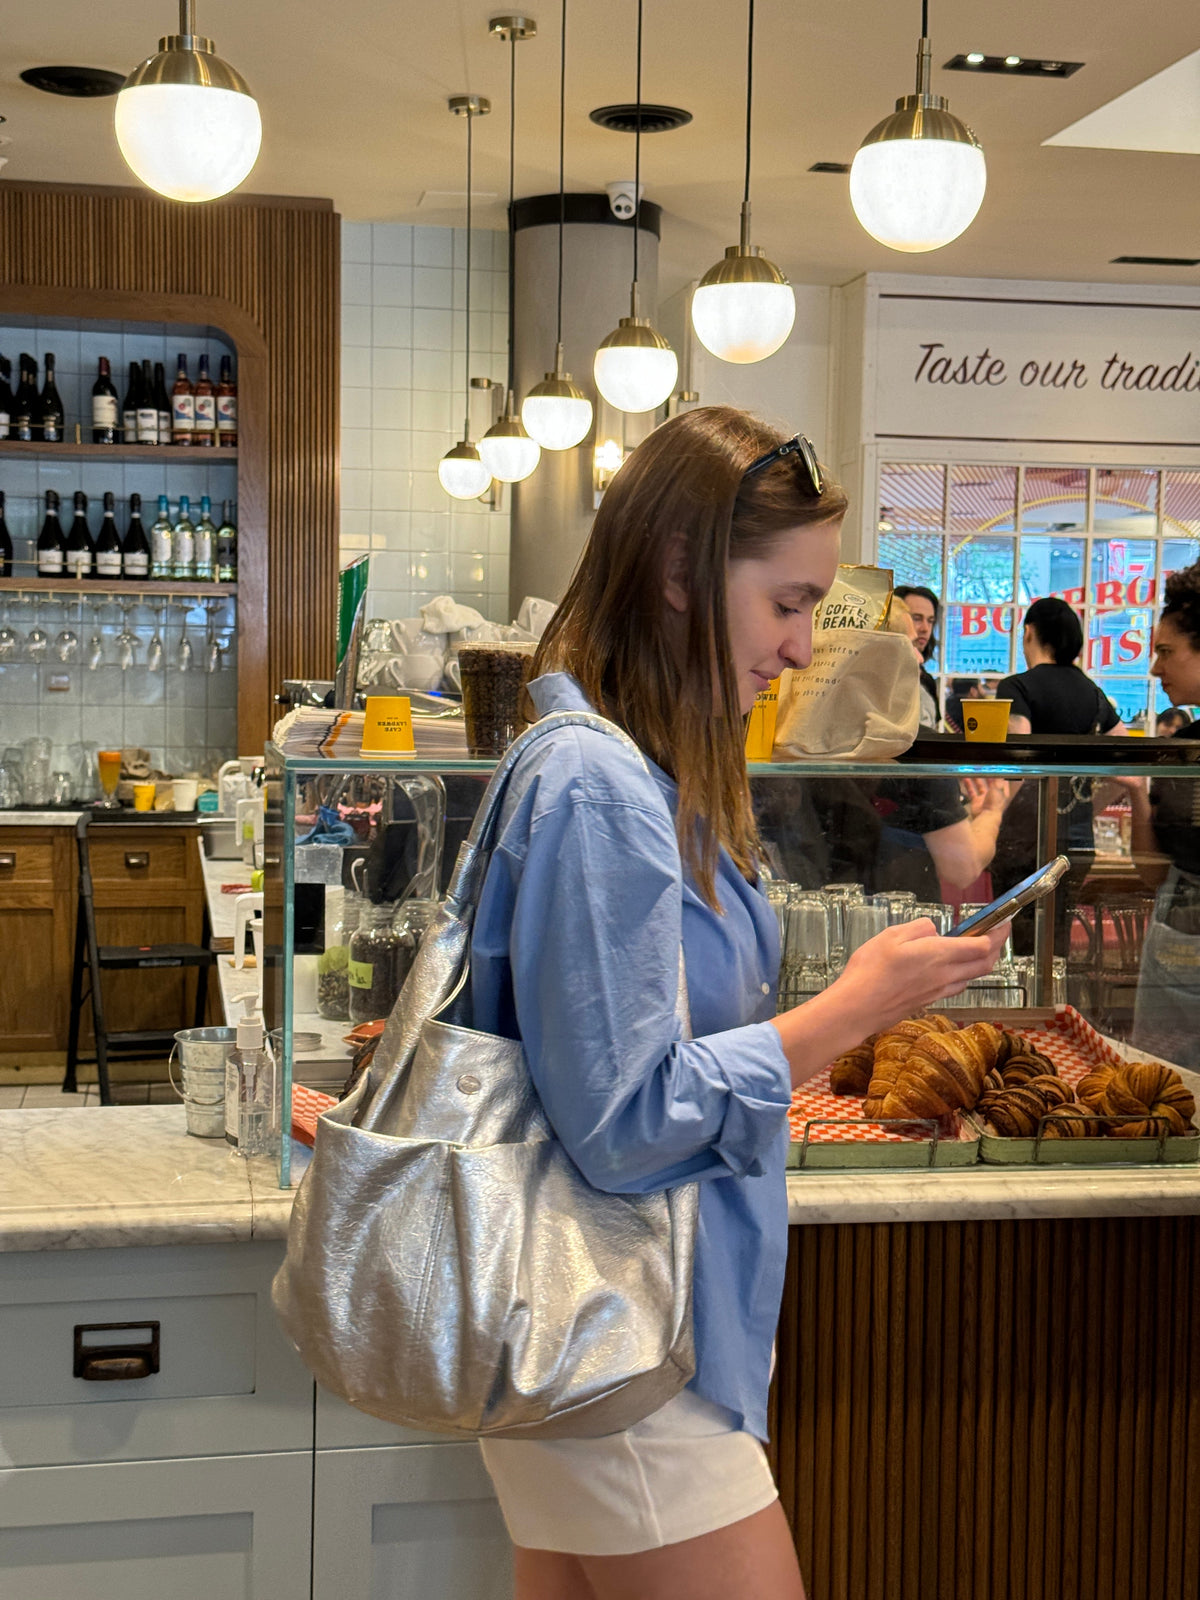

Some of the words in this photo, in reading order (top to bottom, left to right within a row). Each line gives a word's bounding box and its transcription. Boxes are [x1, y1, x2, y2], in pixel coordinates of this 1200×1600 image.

[914, 343, 1008, 386] Taste
[1019, 359, 1088, 390] our
[1100, 351, 1200, 392] tradi
[826, 604, 871, 622] COFFEE
